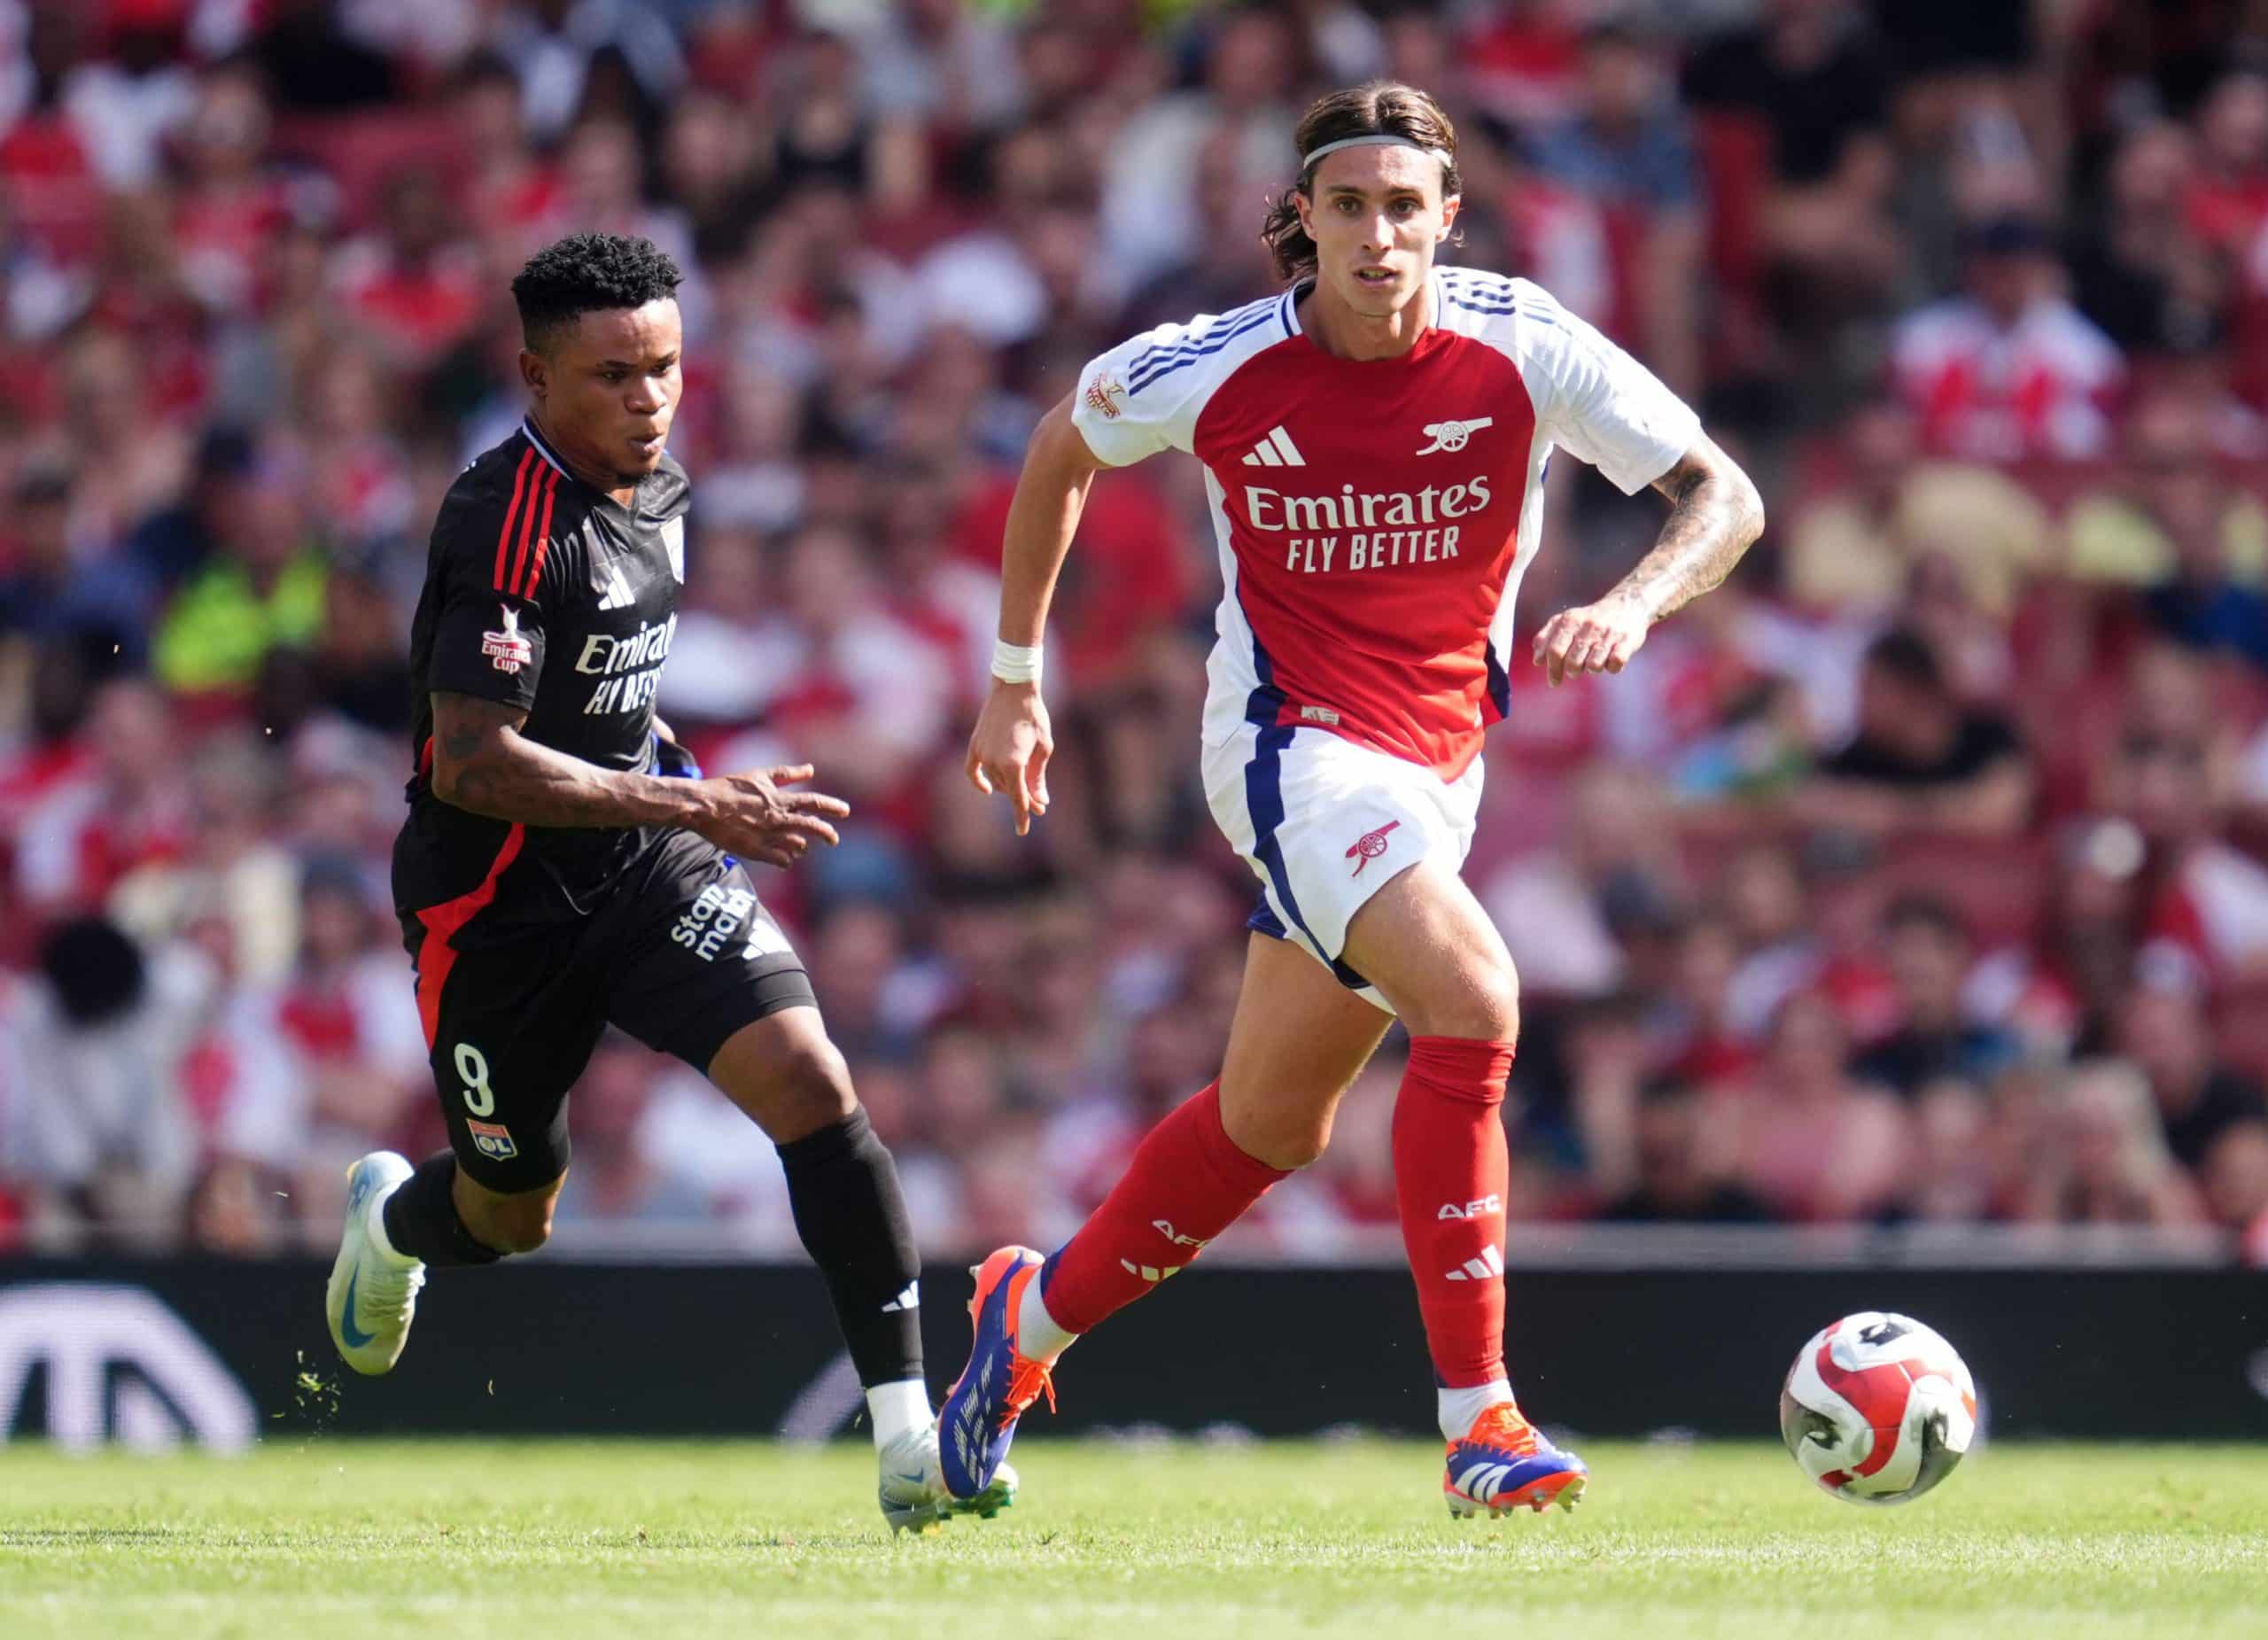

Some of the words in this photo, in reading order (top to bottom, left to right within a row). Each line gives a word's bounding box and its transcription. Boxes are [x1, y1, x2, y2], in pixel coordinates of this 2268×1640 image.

[1244, 476, 1491, 532] Emirates
[1286, 536, 1338, 573] FLY
[1349, 525, 1460, 571] BETTER
[493, 657, 520, 675] Cup
[454, 1043, 495, 1117] 9
[478, 1136, 512, 1153] OL
[1437, 1193, 1503, 1221] AFC
